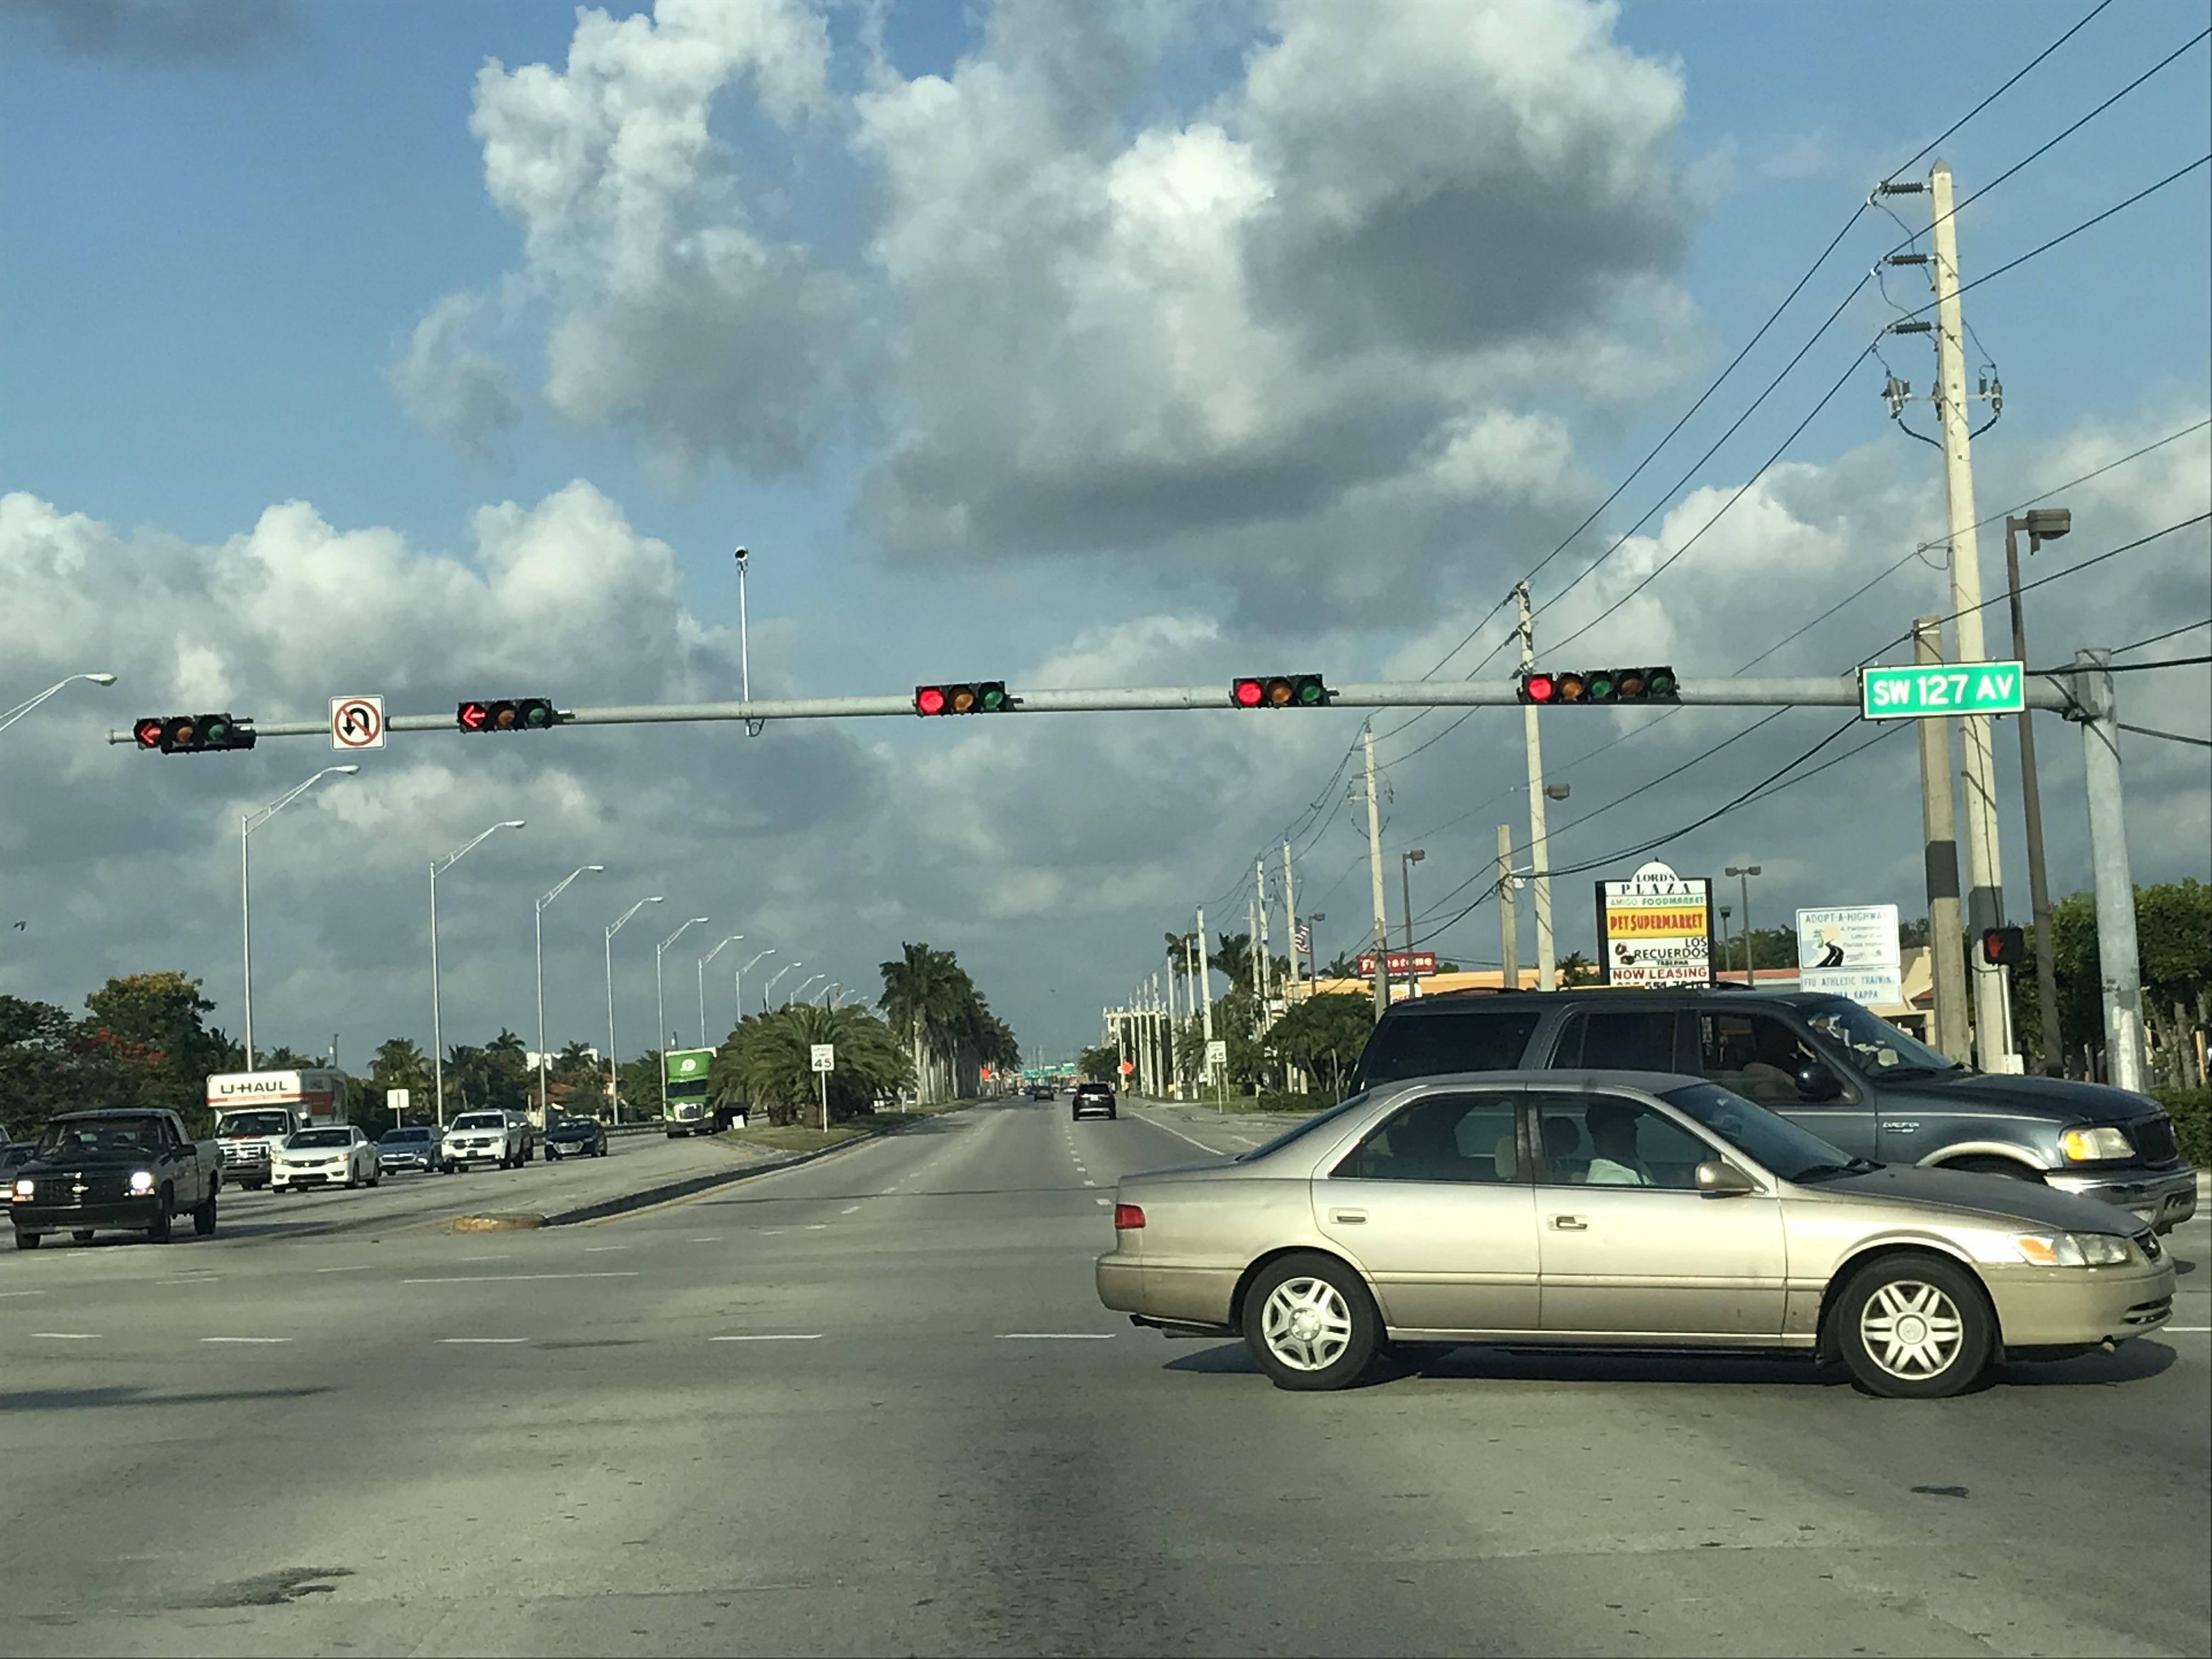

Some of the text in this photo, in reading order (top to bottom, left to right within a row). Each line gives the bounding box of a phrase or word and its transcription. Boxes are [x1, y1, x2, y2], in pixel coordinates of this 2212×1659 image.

[1873, 673, 2014, 706] SW 127 AV
[1636, 872, 1675, 882] LORD'S
[1621, 883, 1691, 895] PLAZA
[1642, 896, 1704, 905] FOODMARKET
[1610, 914, 1703, 931] PET SUPERMARKET
[1685, 937, 1707, 947] LOS
[1634, 947, 1709, 960] RECUERDOS
[1362, 957, 1432, 971] Fistne
[1613, 968, 1707, 979] NOW LEASING
[1821, 977, 1856, 986] ATHLETIC
[1855, 990, 1878, 999] KAPPA
[1210, 1052, 1224, 1060] 45
[814, 1058, 831, 1068] 45
[221, 1081, 288, 1094] U-HAUL
